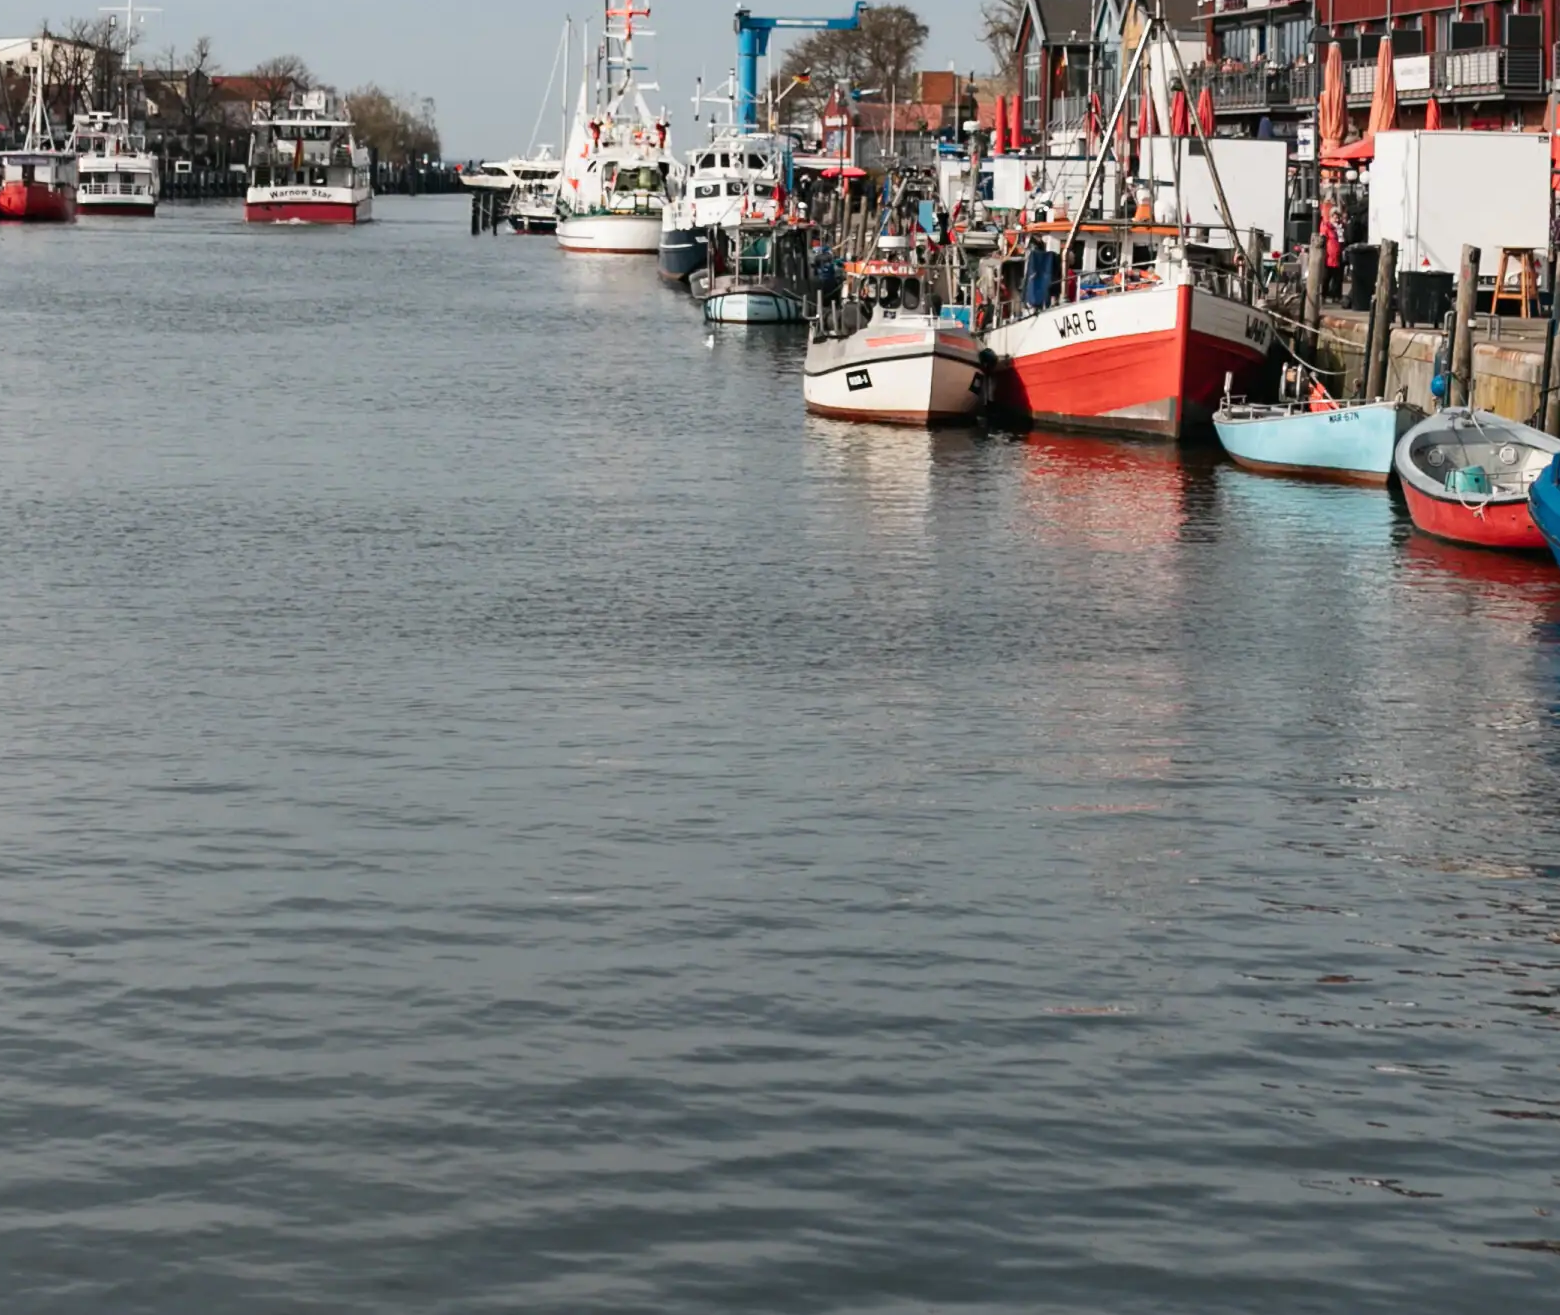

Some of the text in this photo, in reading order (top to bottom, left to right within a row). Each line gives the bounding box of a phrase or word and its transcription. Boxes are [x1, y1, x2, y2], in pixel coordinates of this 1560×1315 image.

[269, 190, 308, 199] Warnow
[312, 189, 332, 199] Star
[1054, 310, 1097, 339] WAR 6
